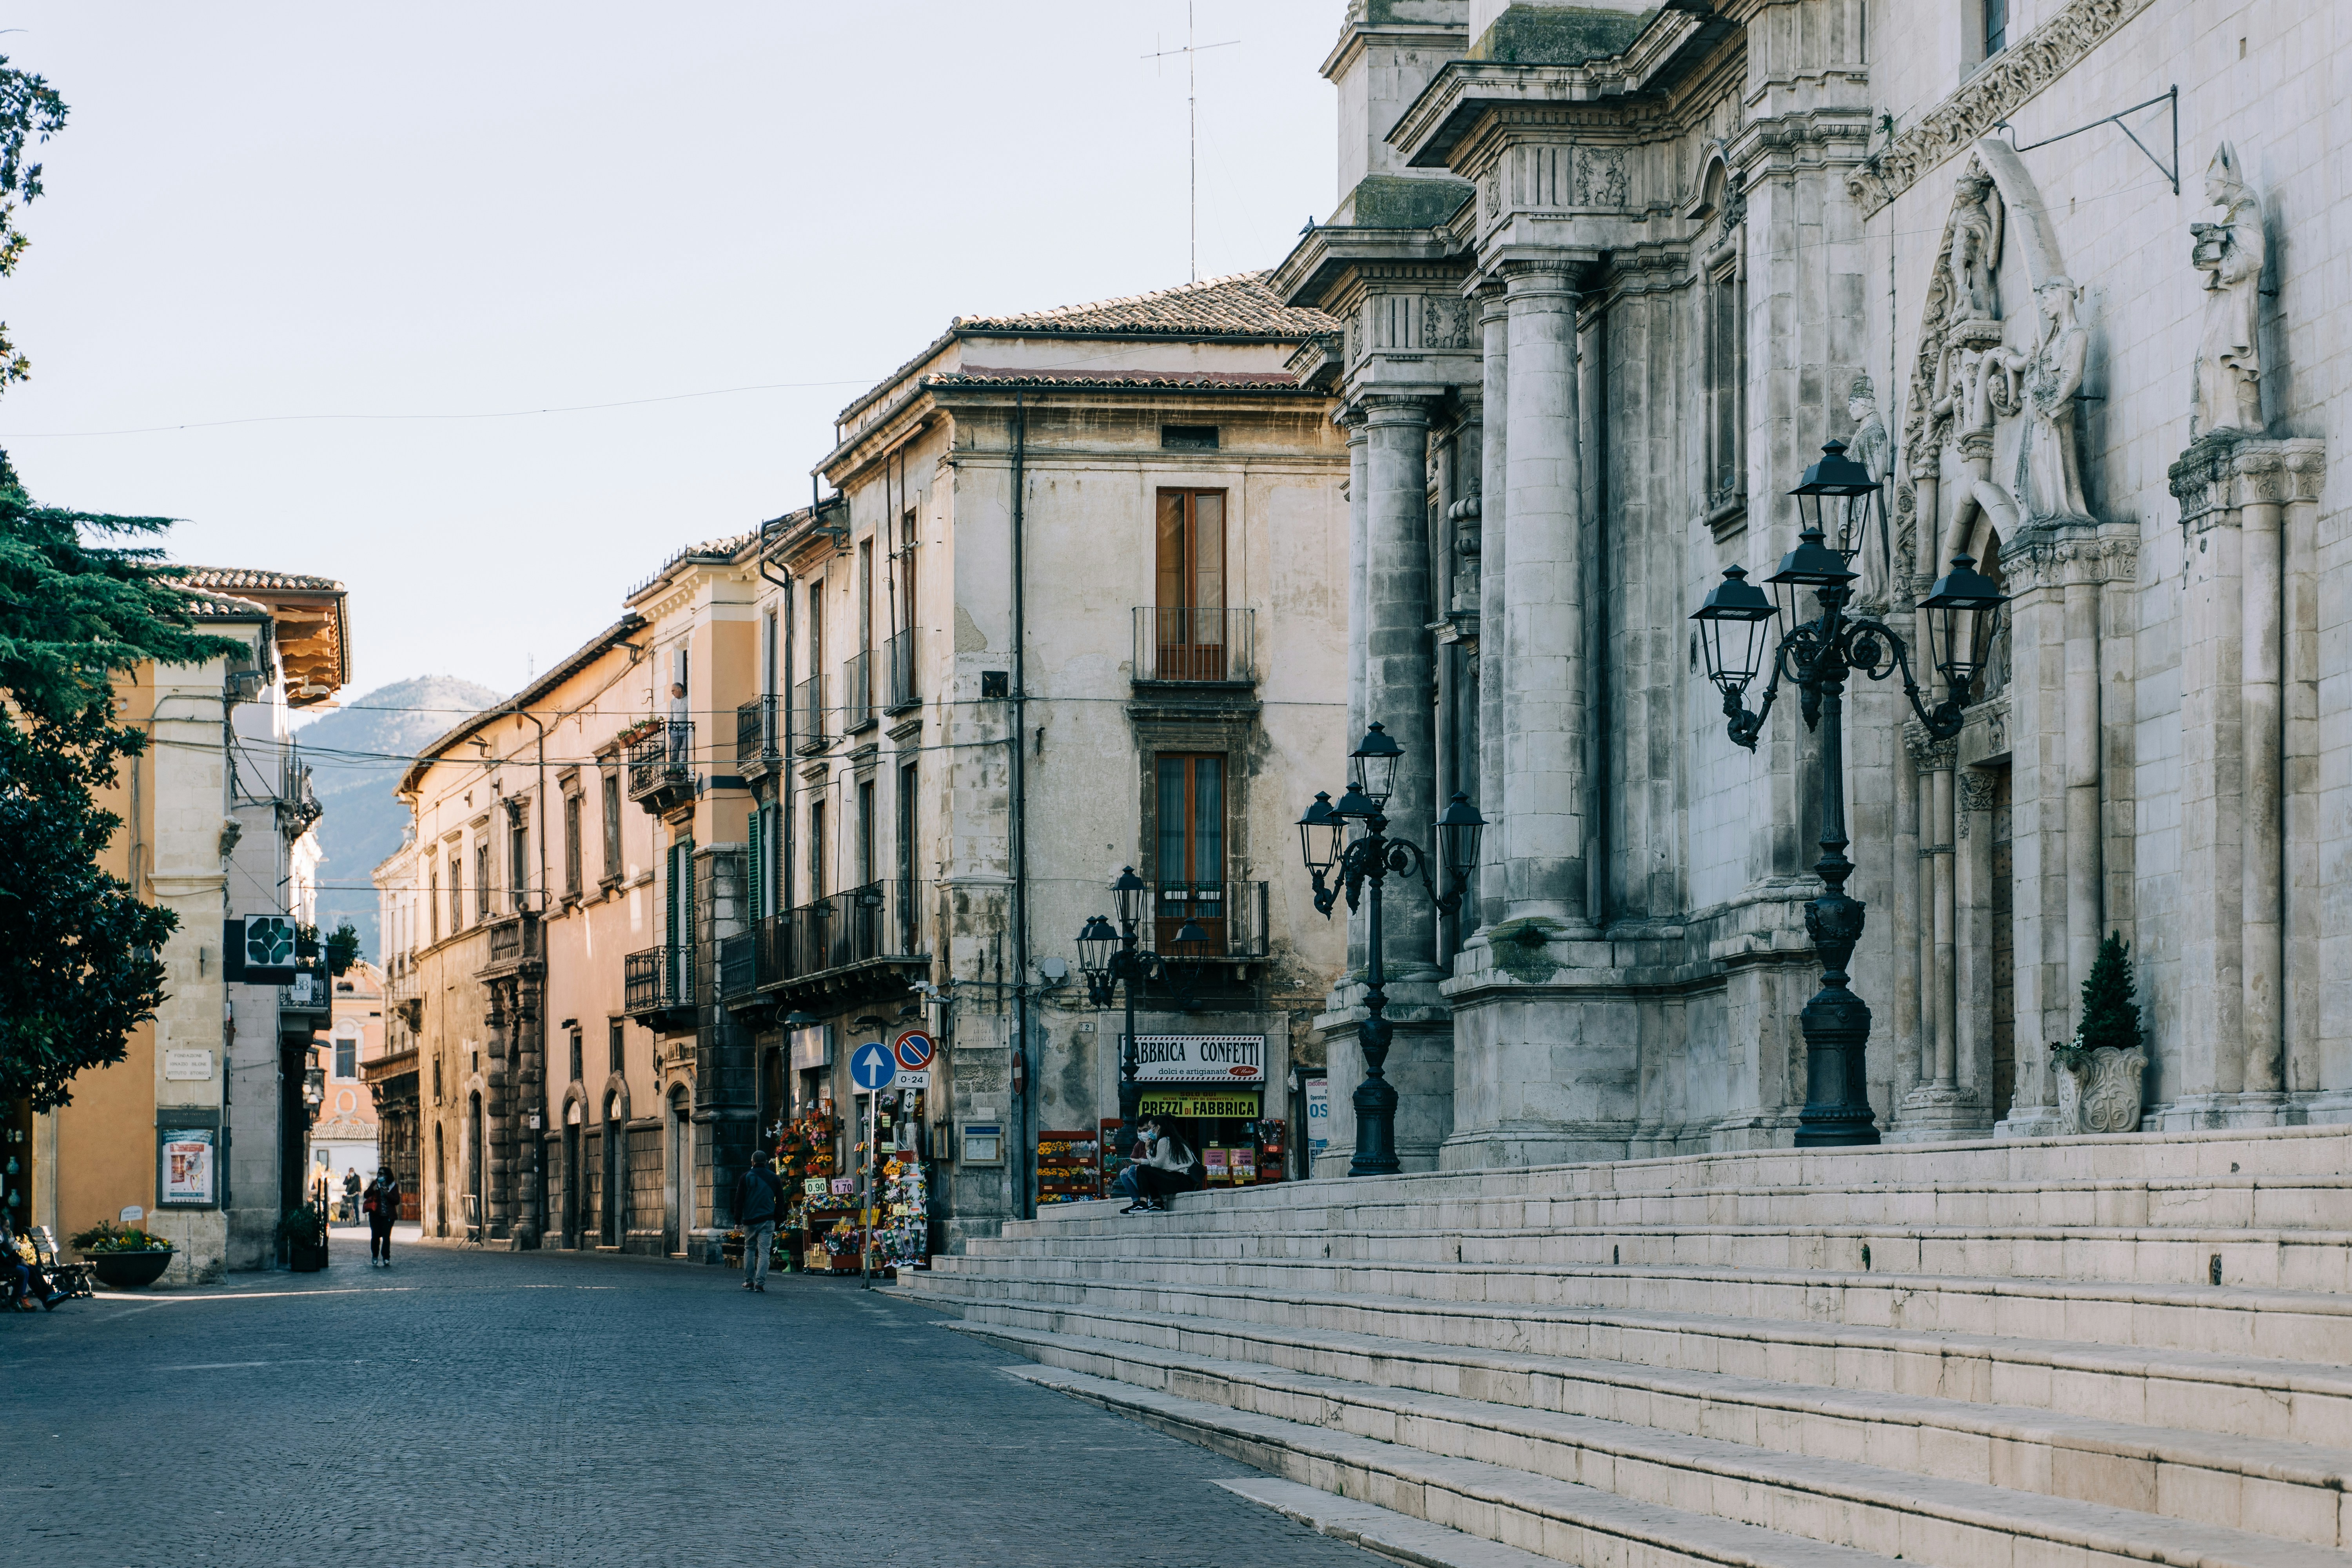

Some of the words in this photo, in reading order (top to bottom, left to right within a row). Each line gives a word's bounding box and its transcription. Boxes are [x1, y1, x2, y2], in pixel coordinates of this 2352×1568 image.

[1134, 1042, 1186, 1065] ABBRICA
[1200, 1042, 1259, 1066] CONFETTI
[1142, 1101, 1183, 1115] PREZZI
[1193, 1101, 1255, 1115] FABBRICA
